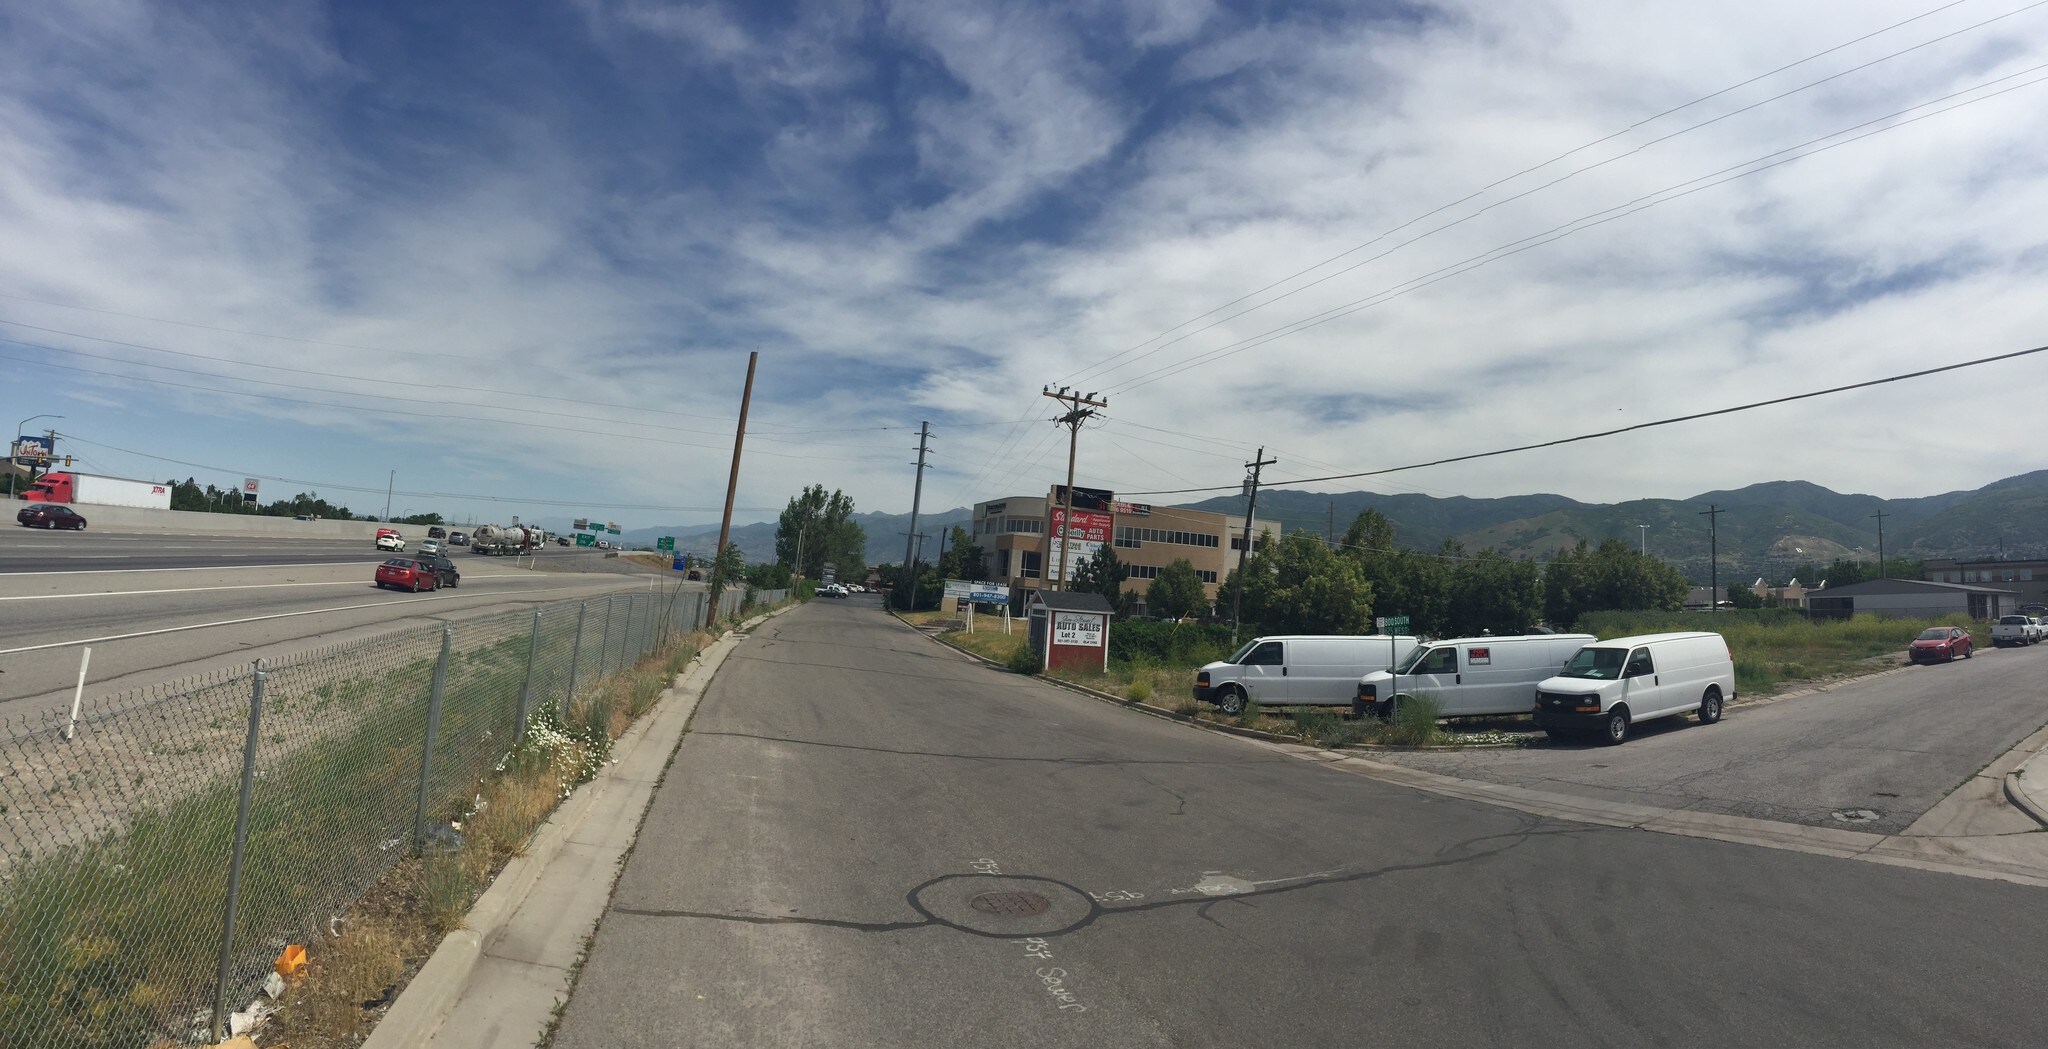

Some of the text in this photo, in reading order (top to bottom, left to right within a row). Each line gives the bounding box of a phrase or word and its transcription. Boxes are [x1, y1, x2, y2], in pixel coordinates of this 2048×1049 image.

[151, 486, 165, 494] XTRA
[1054, 511, 1088, 523] Stdard
[1056, 524, 1086, 538] Oeilly
[1394, 616, 1410, 625] SOUTH
[1056, 622, 1101, 632] AUTO SALES
